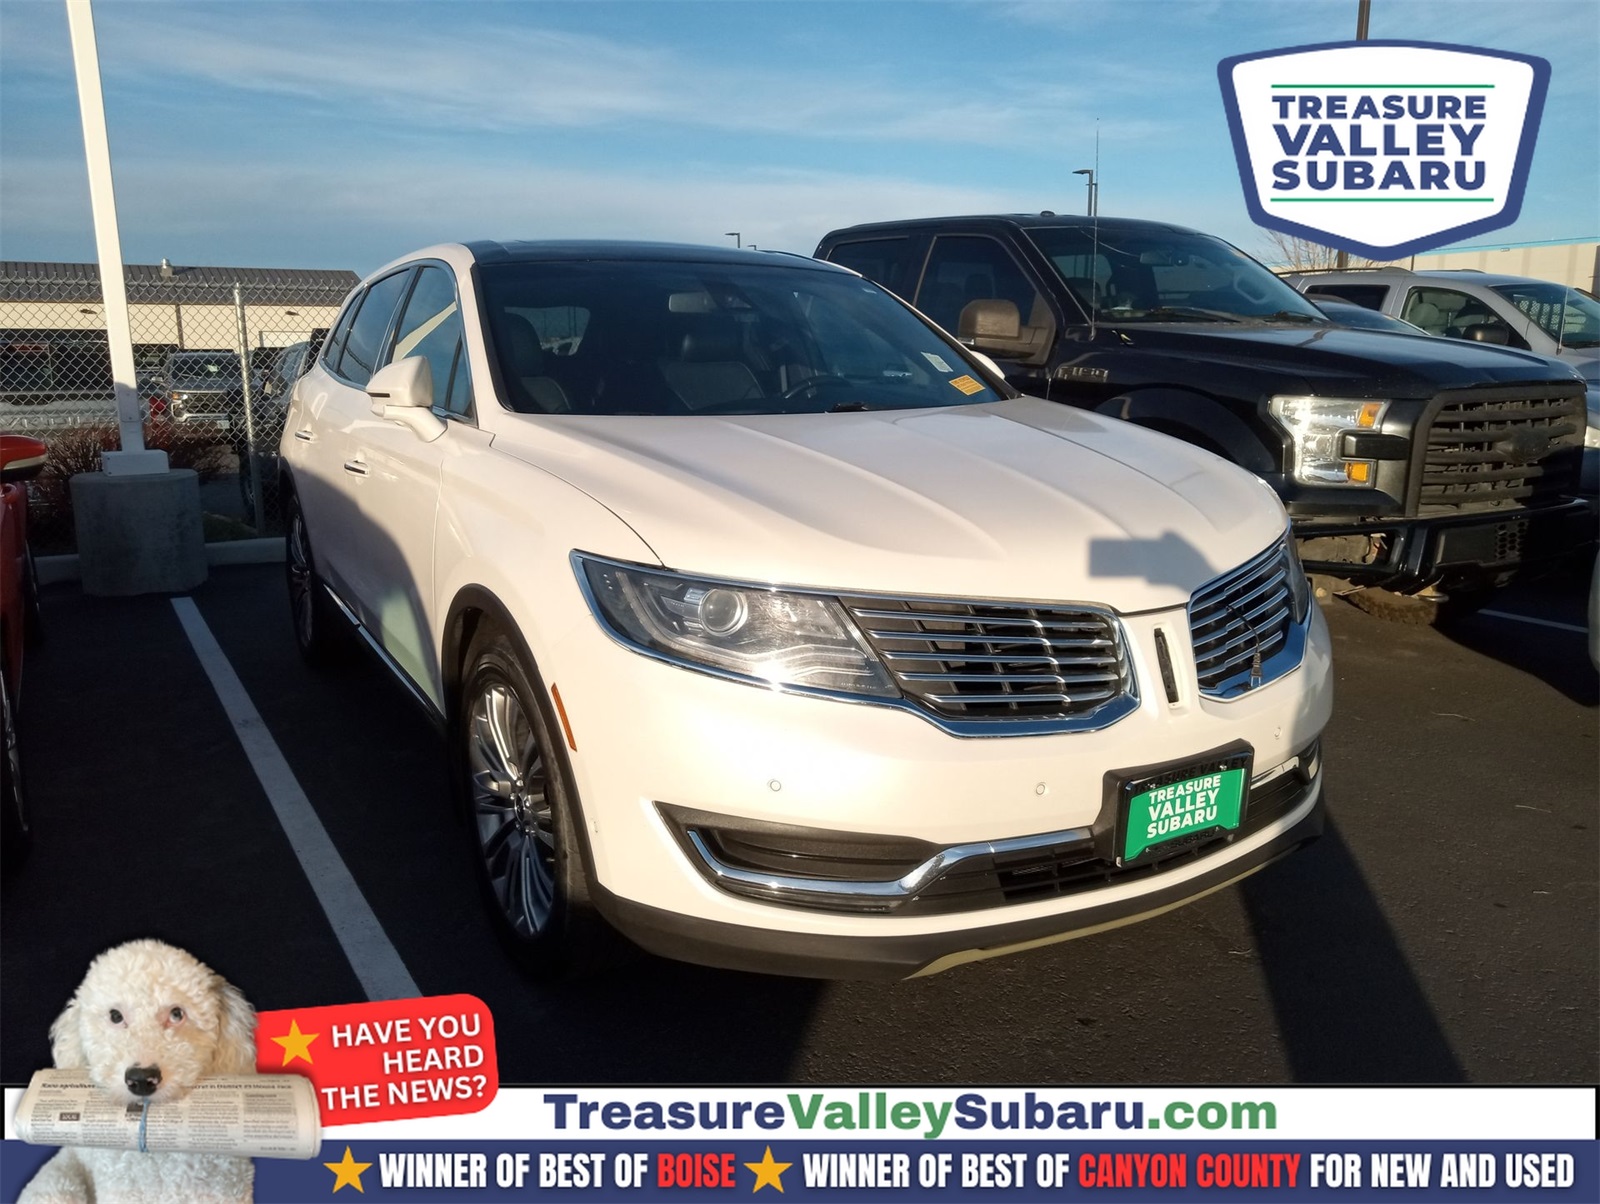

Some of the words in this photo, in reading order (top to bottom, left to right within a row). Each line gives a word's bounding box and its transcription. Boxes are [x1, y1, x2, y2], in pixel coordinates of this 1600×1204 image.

[1148, 788, 1219, 821] VALLEY
[1149, 775, 1221, 804] TREASURE
[1146, 806, 1217, 839] SUBARU
